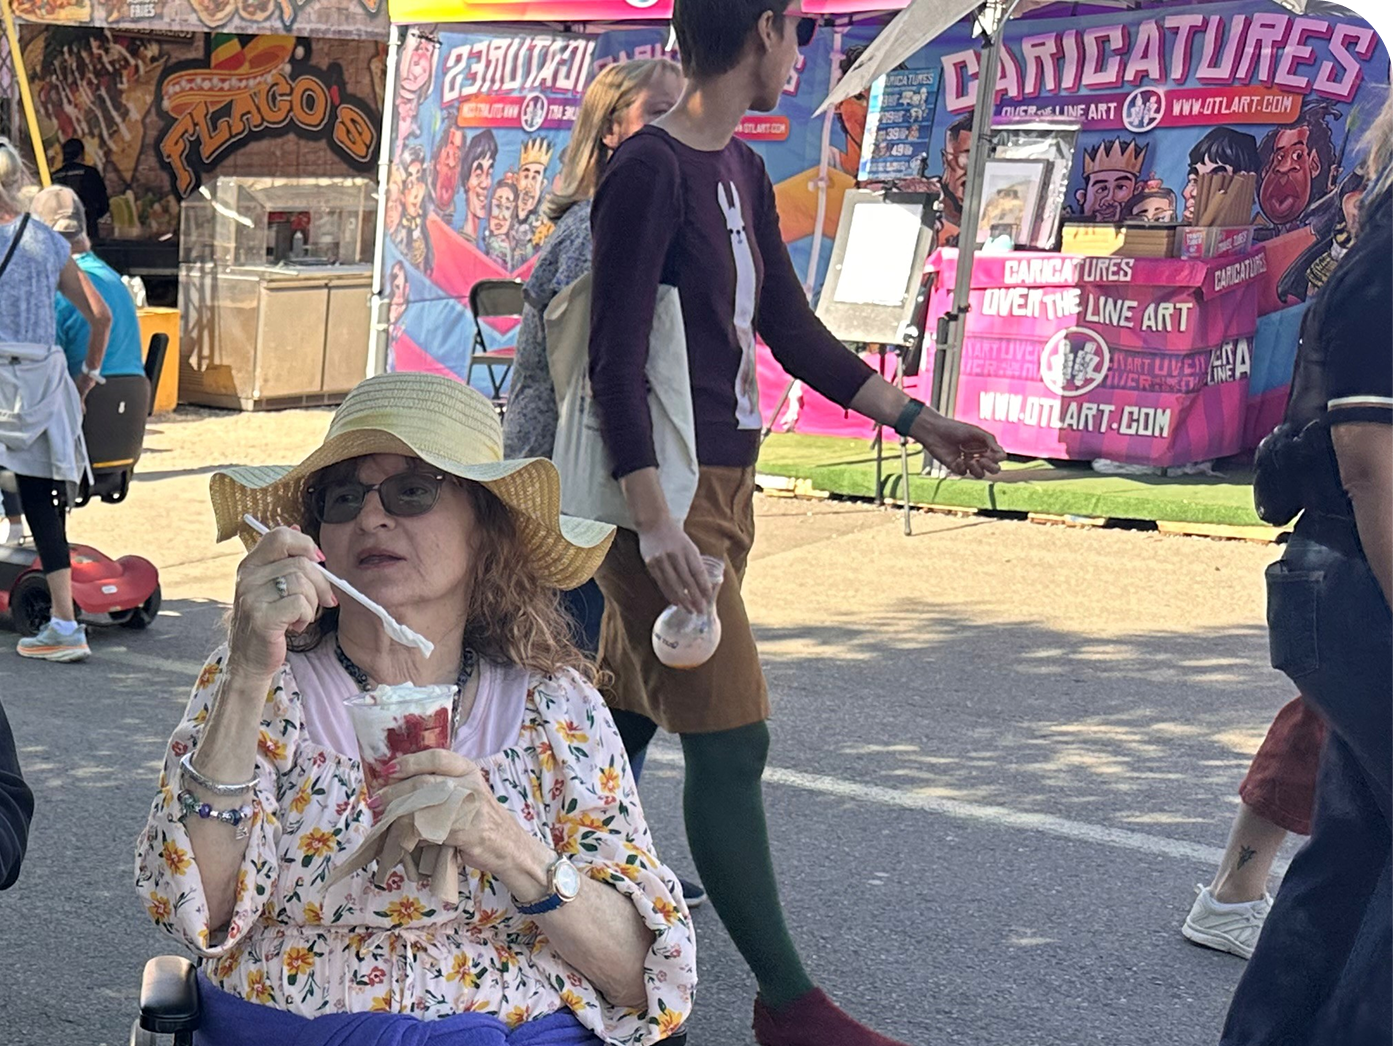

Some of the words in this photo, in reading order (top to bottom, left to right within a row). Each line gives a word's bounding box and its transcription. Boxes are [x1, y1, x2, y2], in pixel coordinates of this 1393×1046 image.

[940, 12, 1377, 112] CARICATURES
[1056, 105, 1085, 119] LINE
[1088, 102, 1117, 120] ART
[1172, 95, 1294, 116] WWW.OTLART.COM
[159, 72, 376, 198] FLACO'S
[1003, 257, 1135, 285] CARICATURES
[1214, 252, 1268, 292] CARICATURES
[981, 287, 1041, 317] OVER
[1042, 288, 1083, 320] THE
[1085, 297, 1139, 328] LINE
[1141, 302, 1194, 333] ART
[979, 391, 1172, 438] WWW.OTLART.COM
